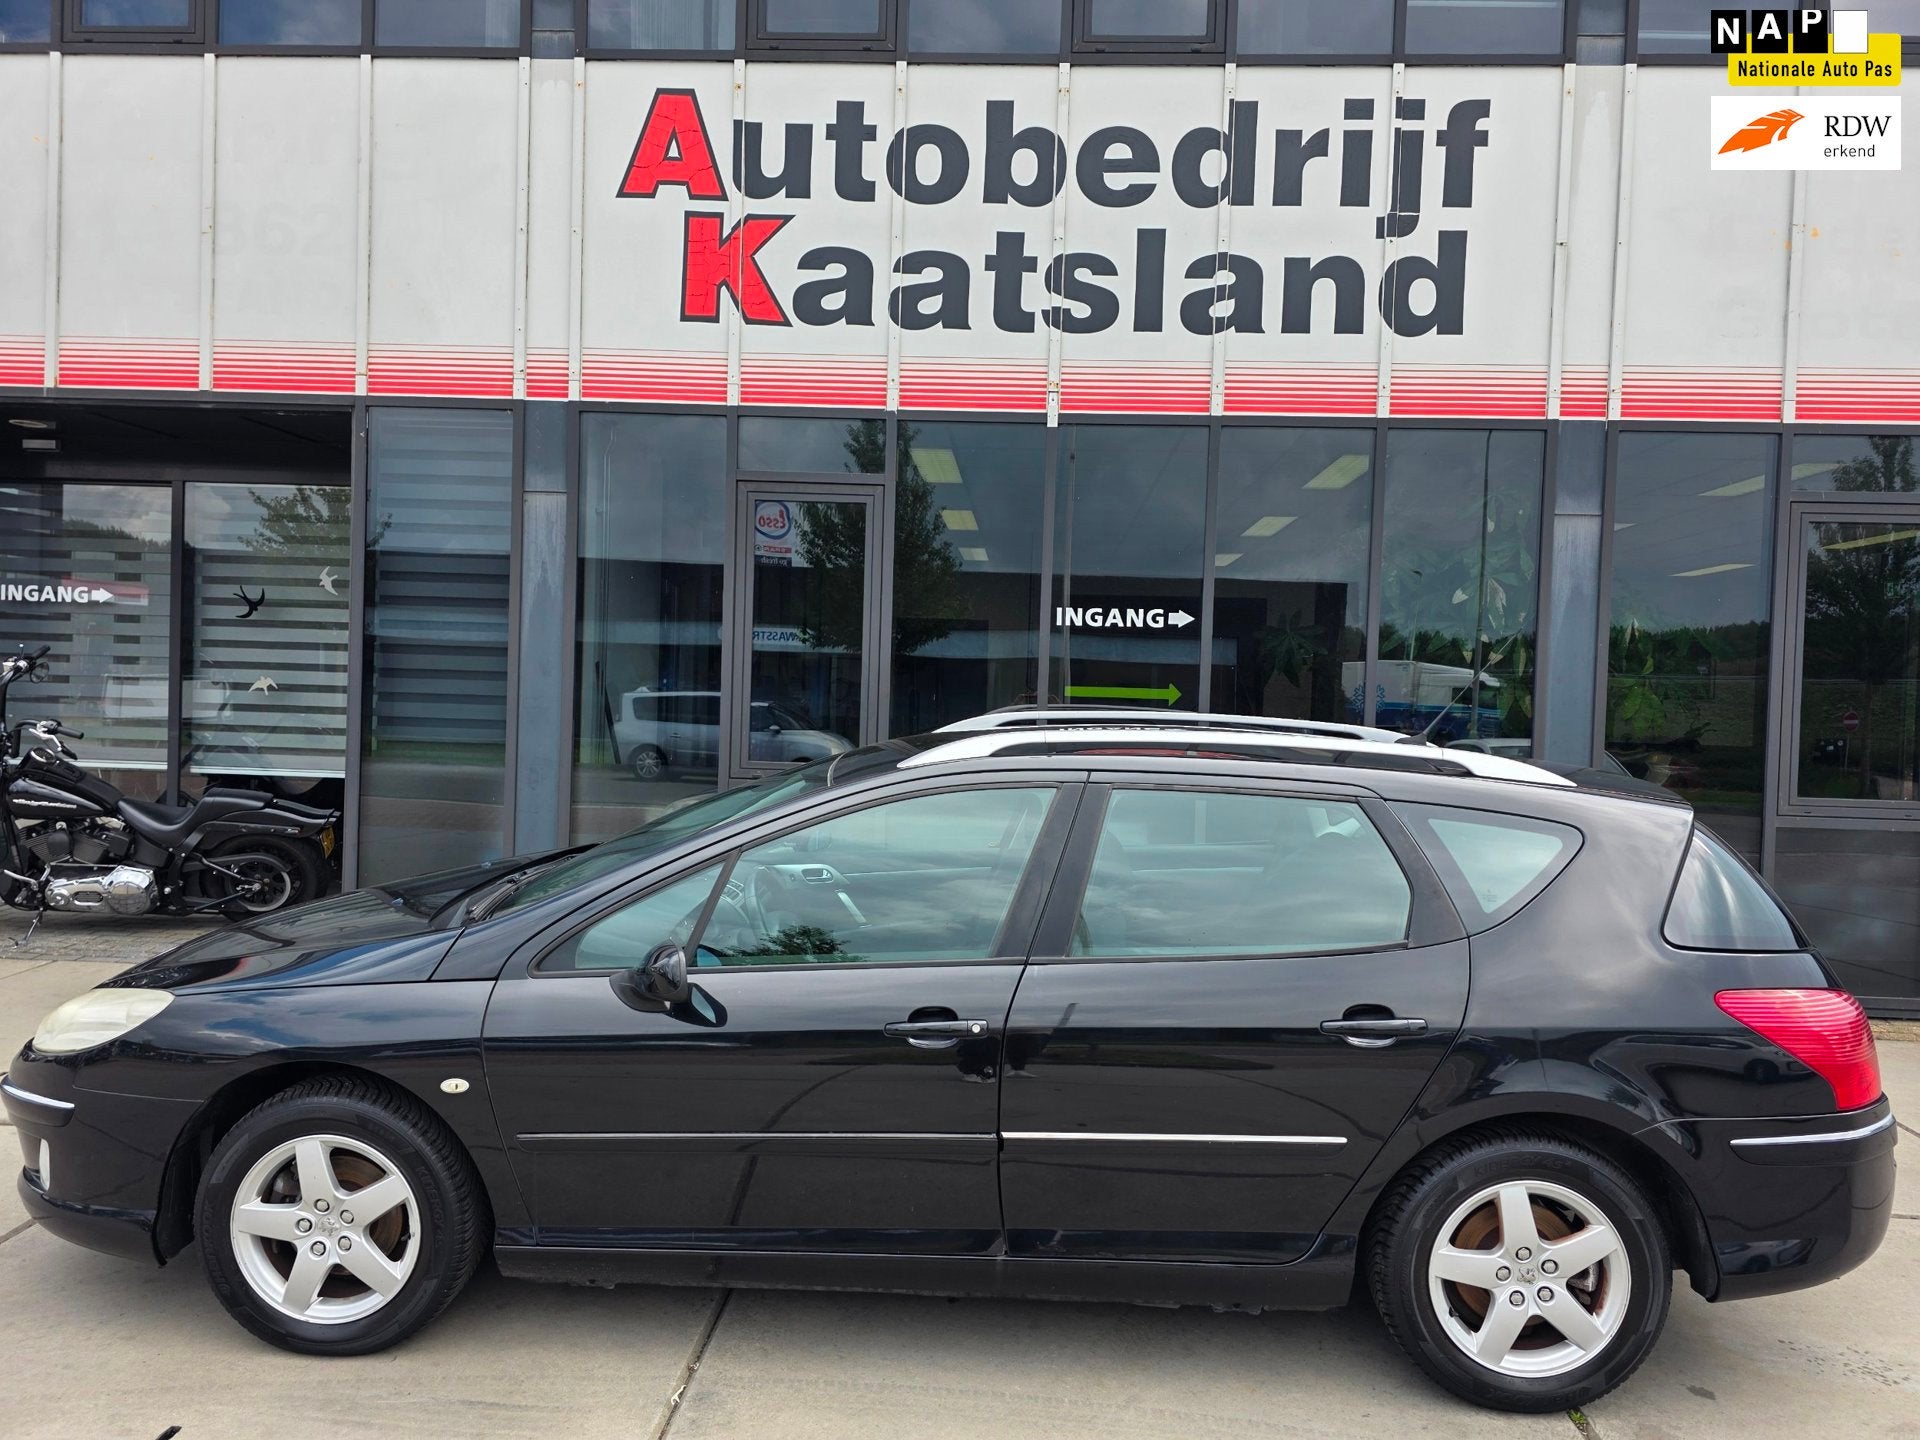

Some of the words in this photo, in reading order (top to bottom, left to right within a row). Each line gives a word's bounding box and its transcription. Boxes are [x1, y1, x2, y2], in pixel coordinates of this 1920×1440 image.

[616, 87, 1491, 238] Autobedrijf
[679, 211, 1468, 336] Kaatsland
[0, 584, 89, 603] INGANG
[1056, 607, 1165, 628] INGANG
